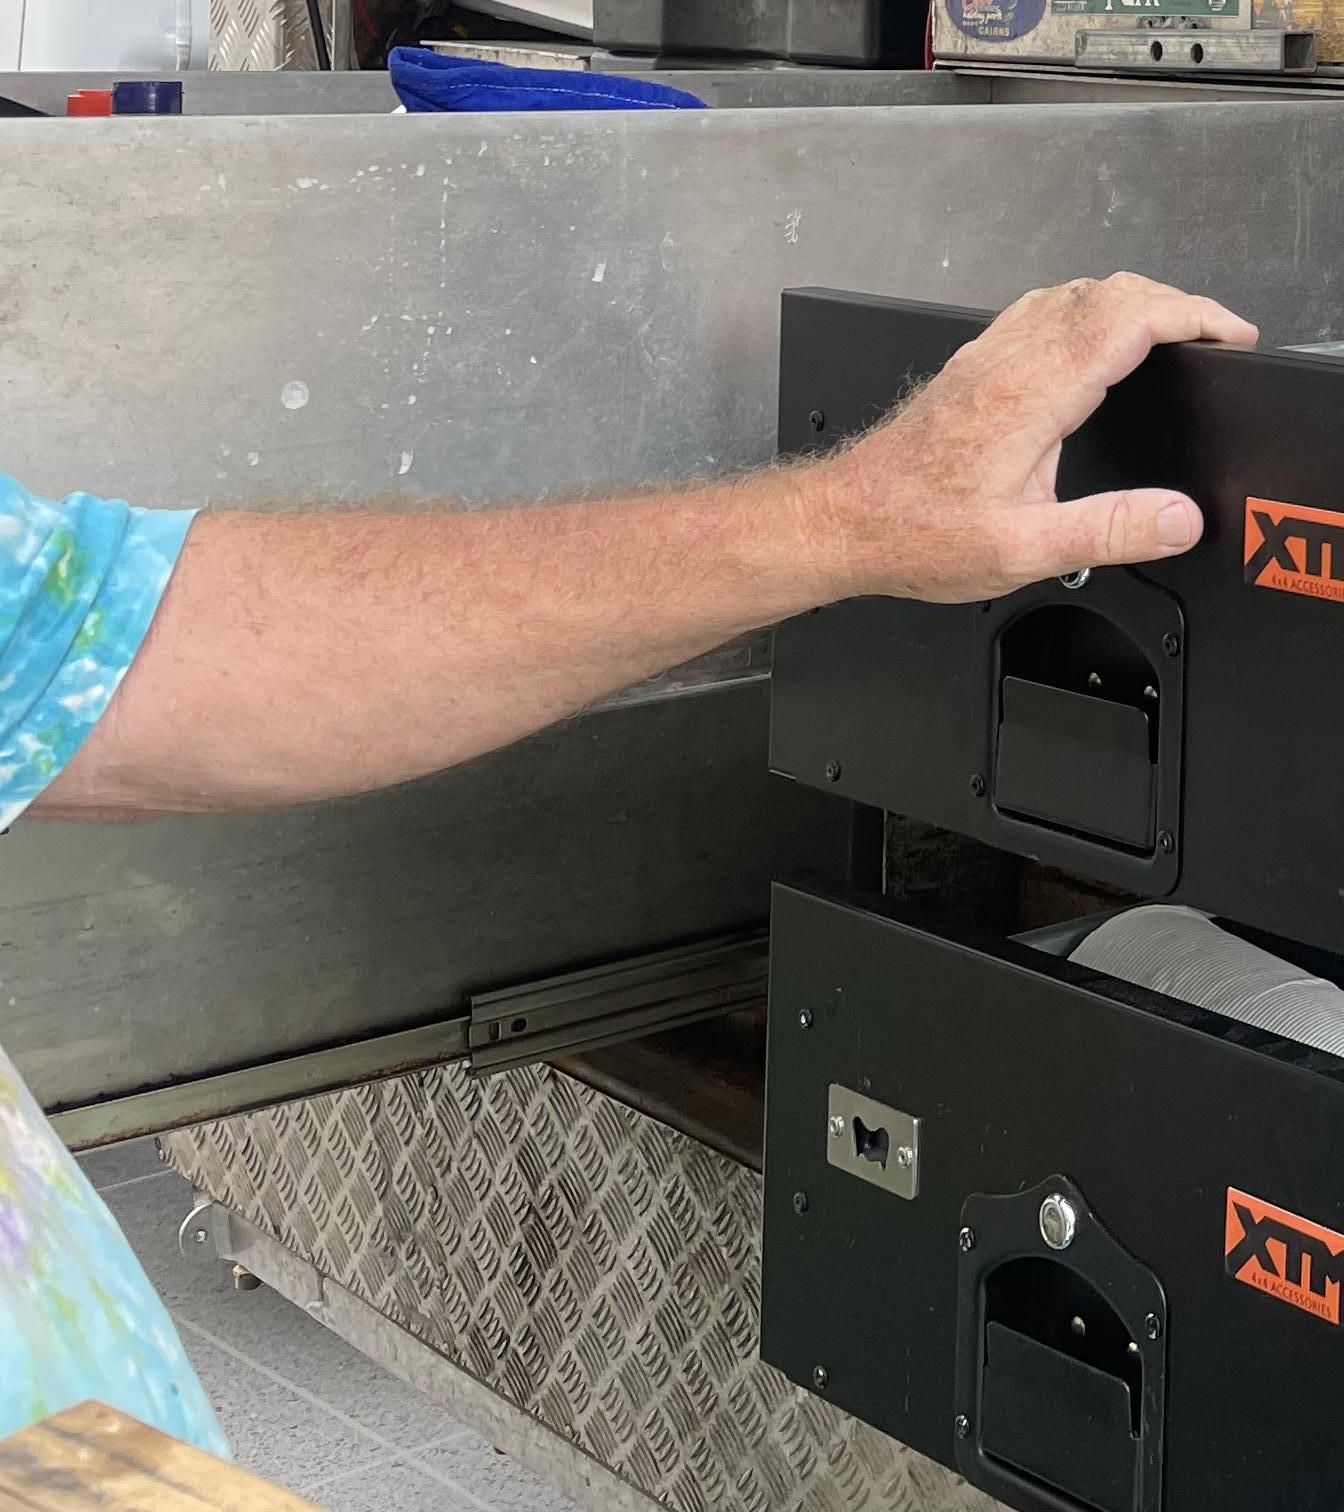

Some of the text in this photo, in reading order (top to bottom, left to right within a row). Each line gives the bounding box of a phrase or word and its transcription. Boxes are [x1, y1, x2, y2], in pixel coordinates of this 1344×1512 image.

[978, 26, 1010, 36] CAIRNS
[1271, 573, 1288, 589] 4x4
[1251, 1272, 1332, 1318] 4x4 ACCESSORIES
